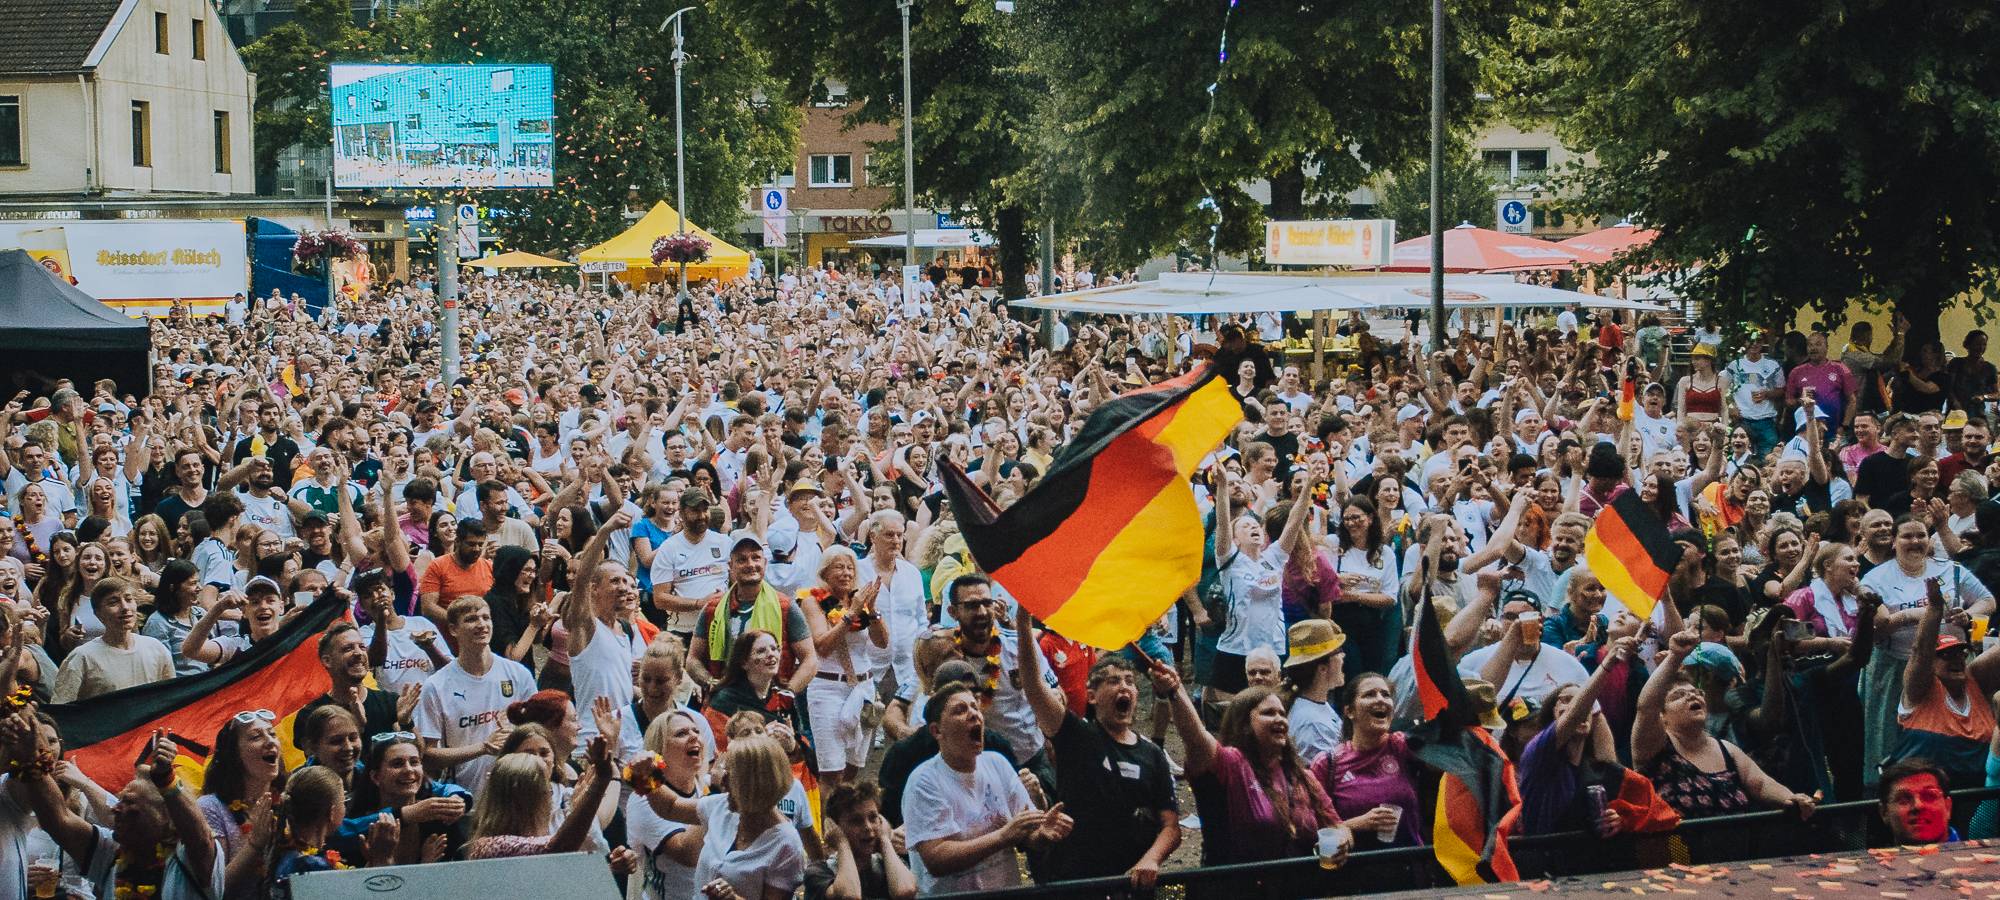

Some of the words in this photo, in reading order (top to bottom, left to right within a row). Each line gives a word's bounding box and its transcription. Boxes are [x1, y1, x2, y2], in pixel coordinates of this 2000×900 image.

[96, 249, 168, 265] Reissdorf
[171, 248, 221, 268] Kölsch
[459, 710, 500, 728] CHECK
